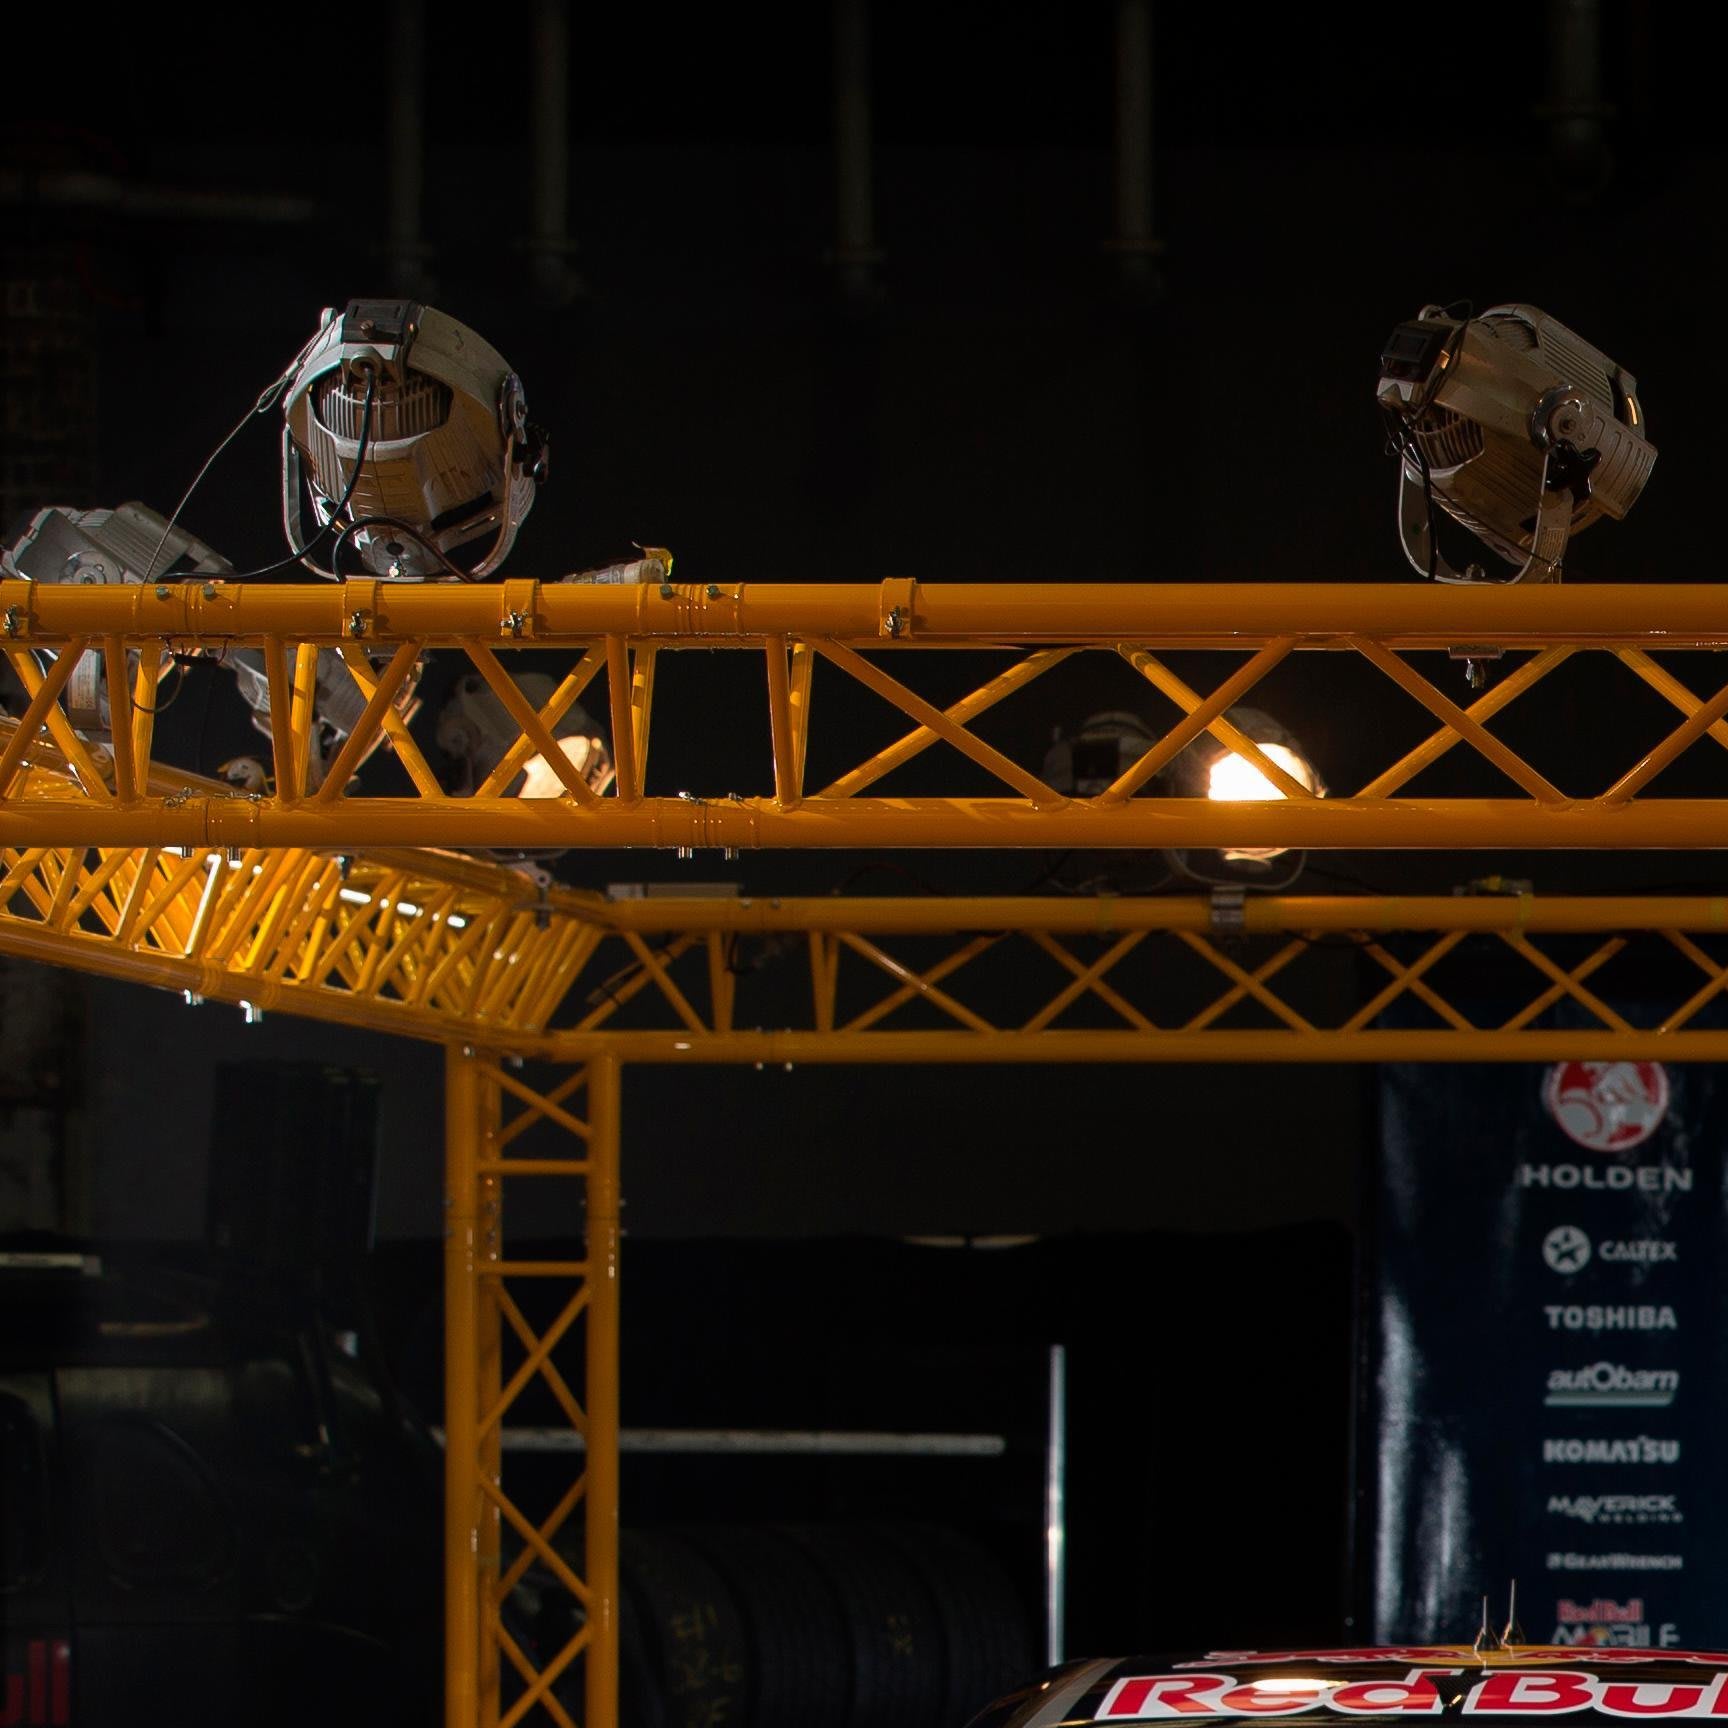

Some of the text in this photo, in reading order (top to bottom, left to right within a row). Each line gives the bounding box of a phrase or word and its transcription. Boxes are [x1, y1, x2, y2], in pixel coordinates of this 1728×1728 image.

[1520, 1163, 1693, 1191] HOLDEN
[1598, 1240, 1678, 1262] CALTEX
[1543, 1305, 1678, 1330] TOSHIBA
[1542, 1434, 1681, 1464] KOMATSU
[1096, 1670, 1452, 1720] Red
